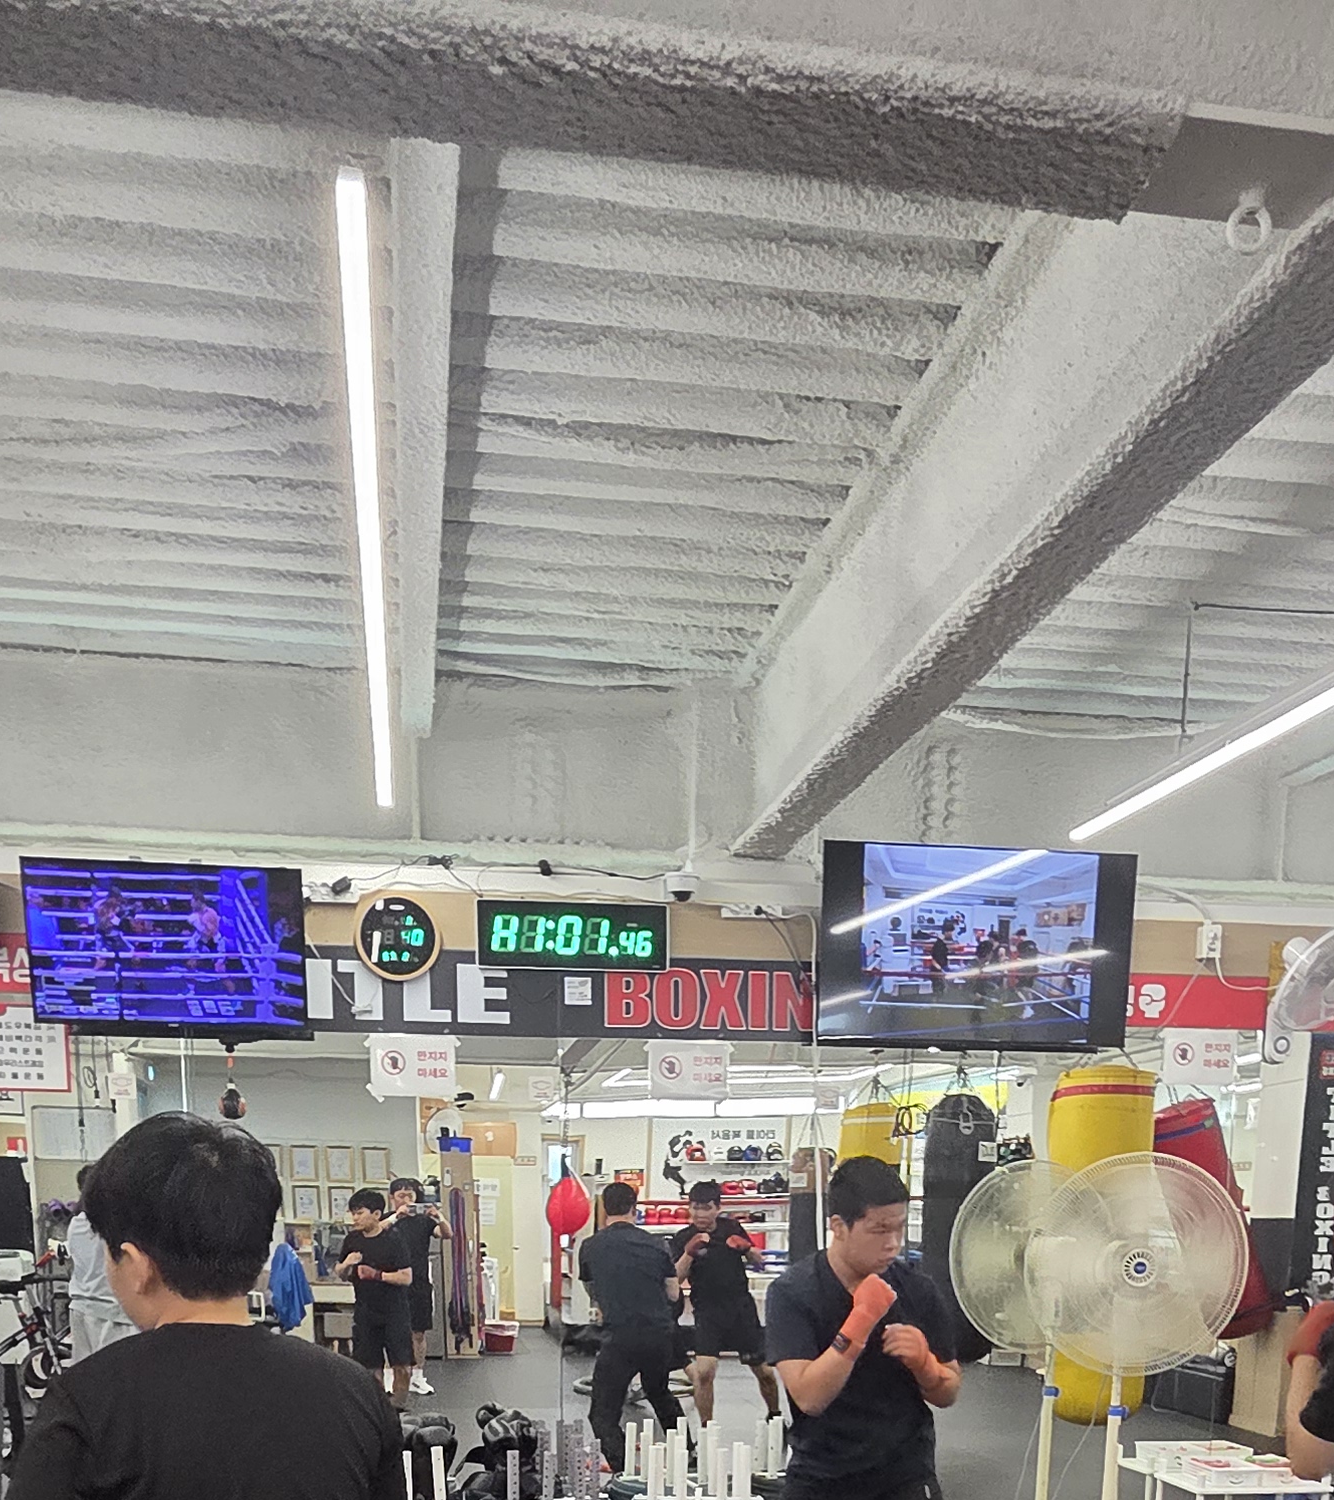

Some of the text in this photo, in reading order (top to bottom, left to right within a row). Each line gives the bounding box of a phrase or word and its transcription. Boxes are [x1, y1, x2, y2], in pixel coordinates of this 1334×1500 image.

[304, 957, 511, 1025] ITLE
[604, 968, 814, 1032] BOXIN
[417, 1051, 448, 1062] 만지지
[417, 1067, 449, 1079] 마세요
